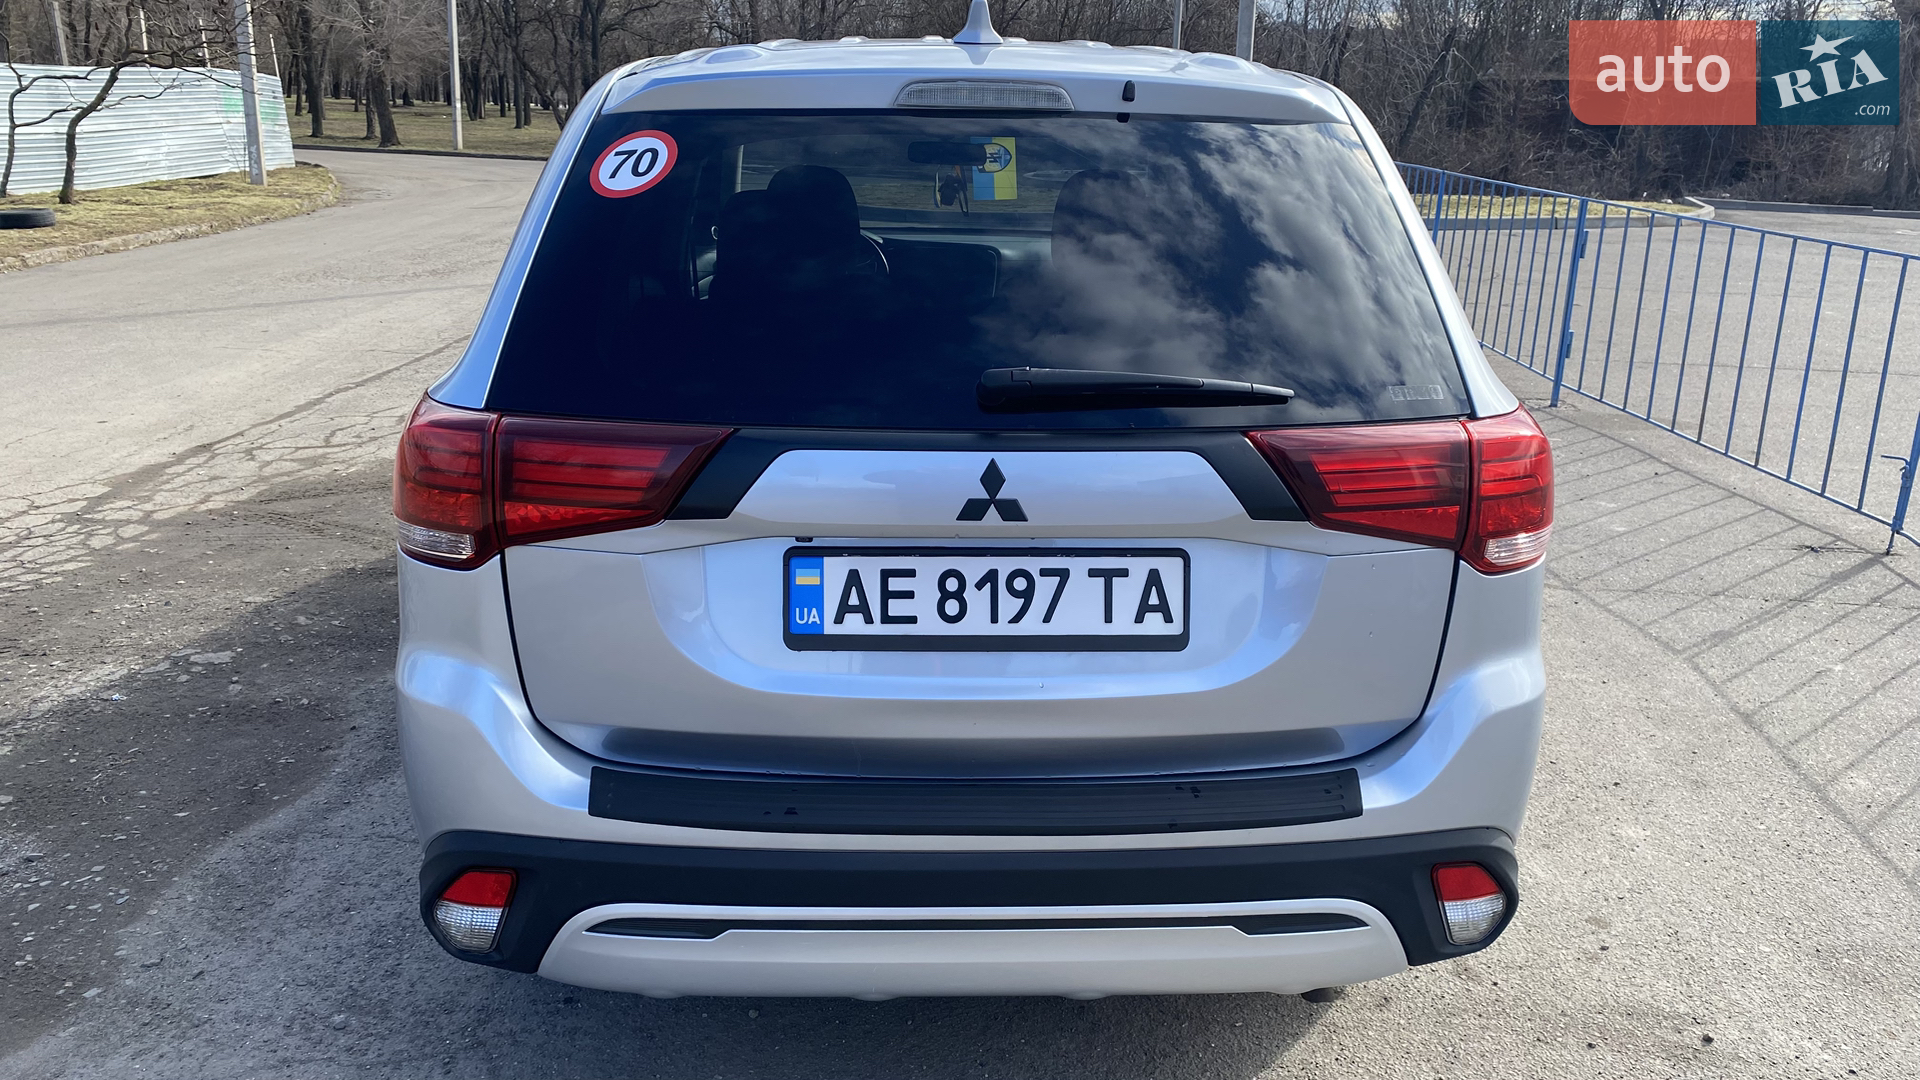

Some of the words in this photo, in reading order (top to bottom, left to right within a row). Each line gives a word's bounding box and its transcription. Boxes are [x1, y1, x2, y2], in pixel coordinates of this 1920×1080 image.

[608, 147, 659, 180] 70
[833, 568, 918, 625] AE
[936, 568, 1071, 625] 8197
[1087, 568, 1174, 625] TA
[795, 608, 820, 625] UA
